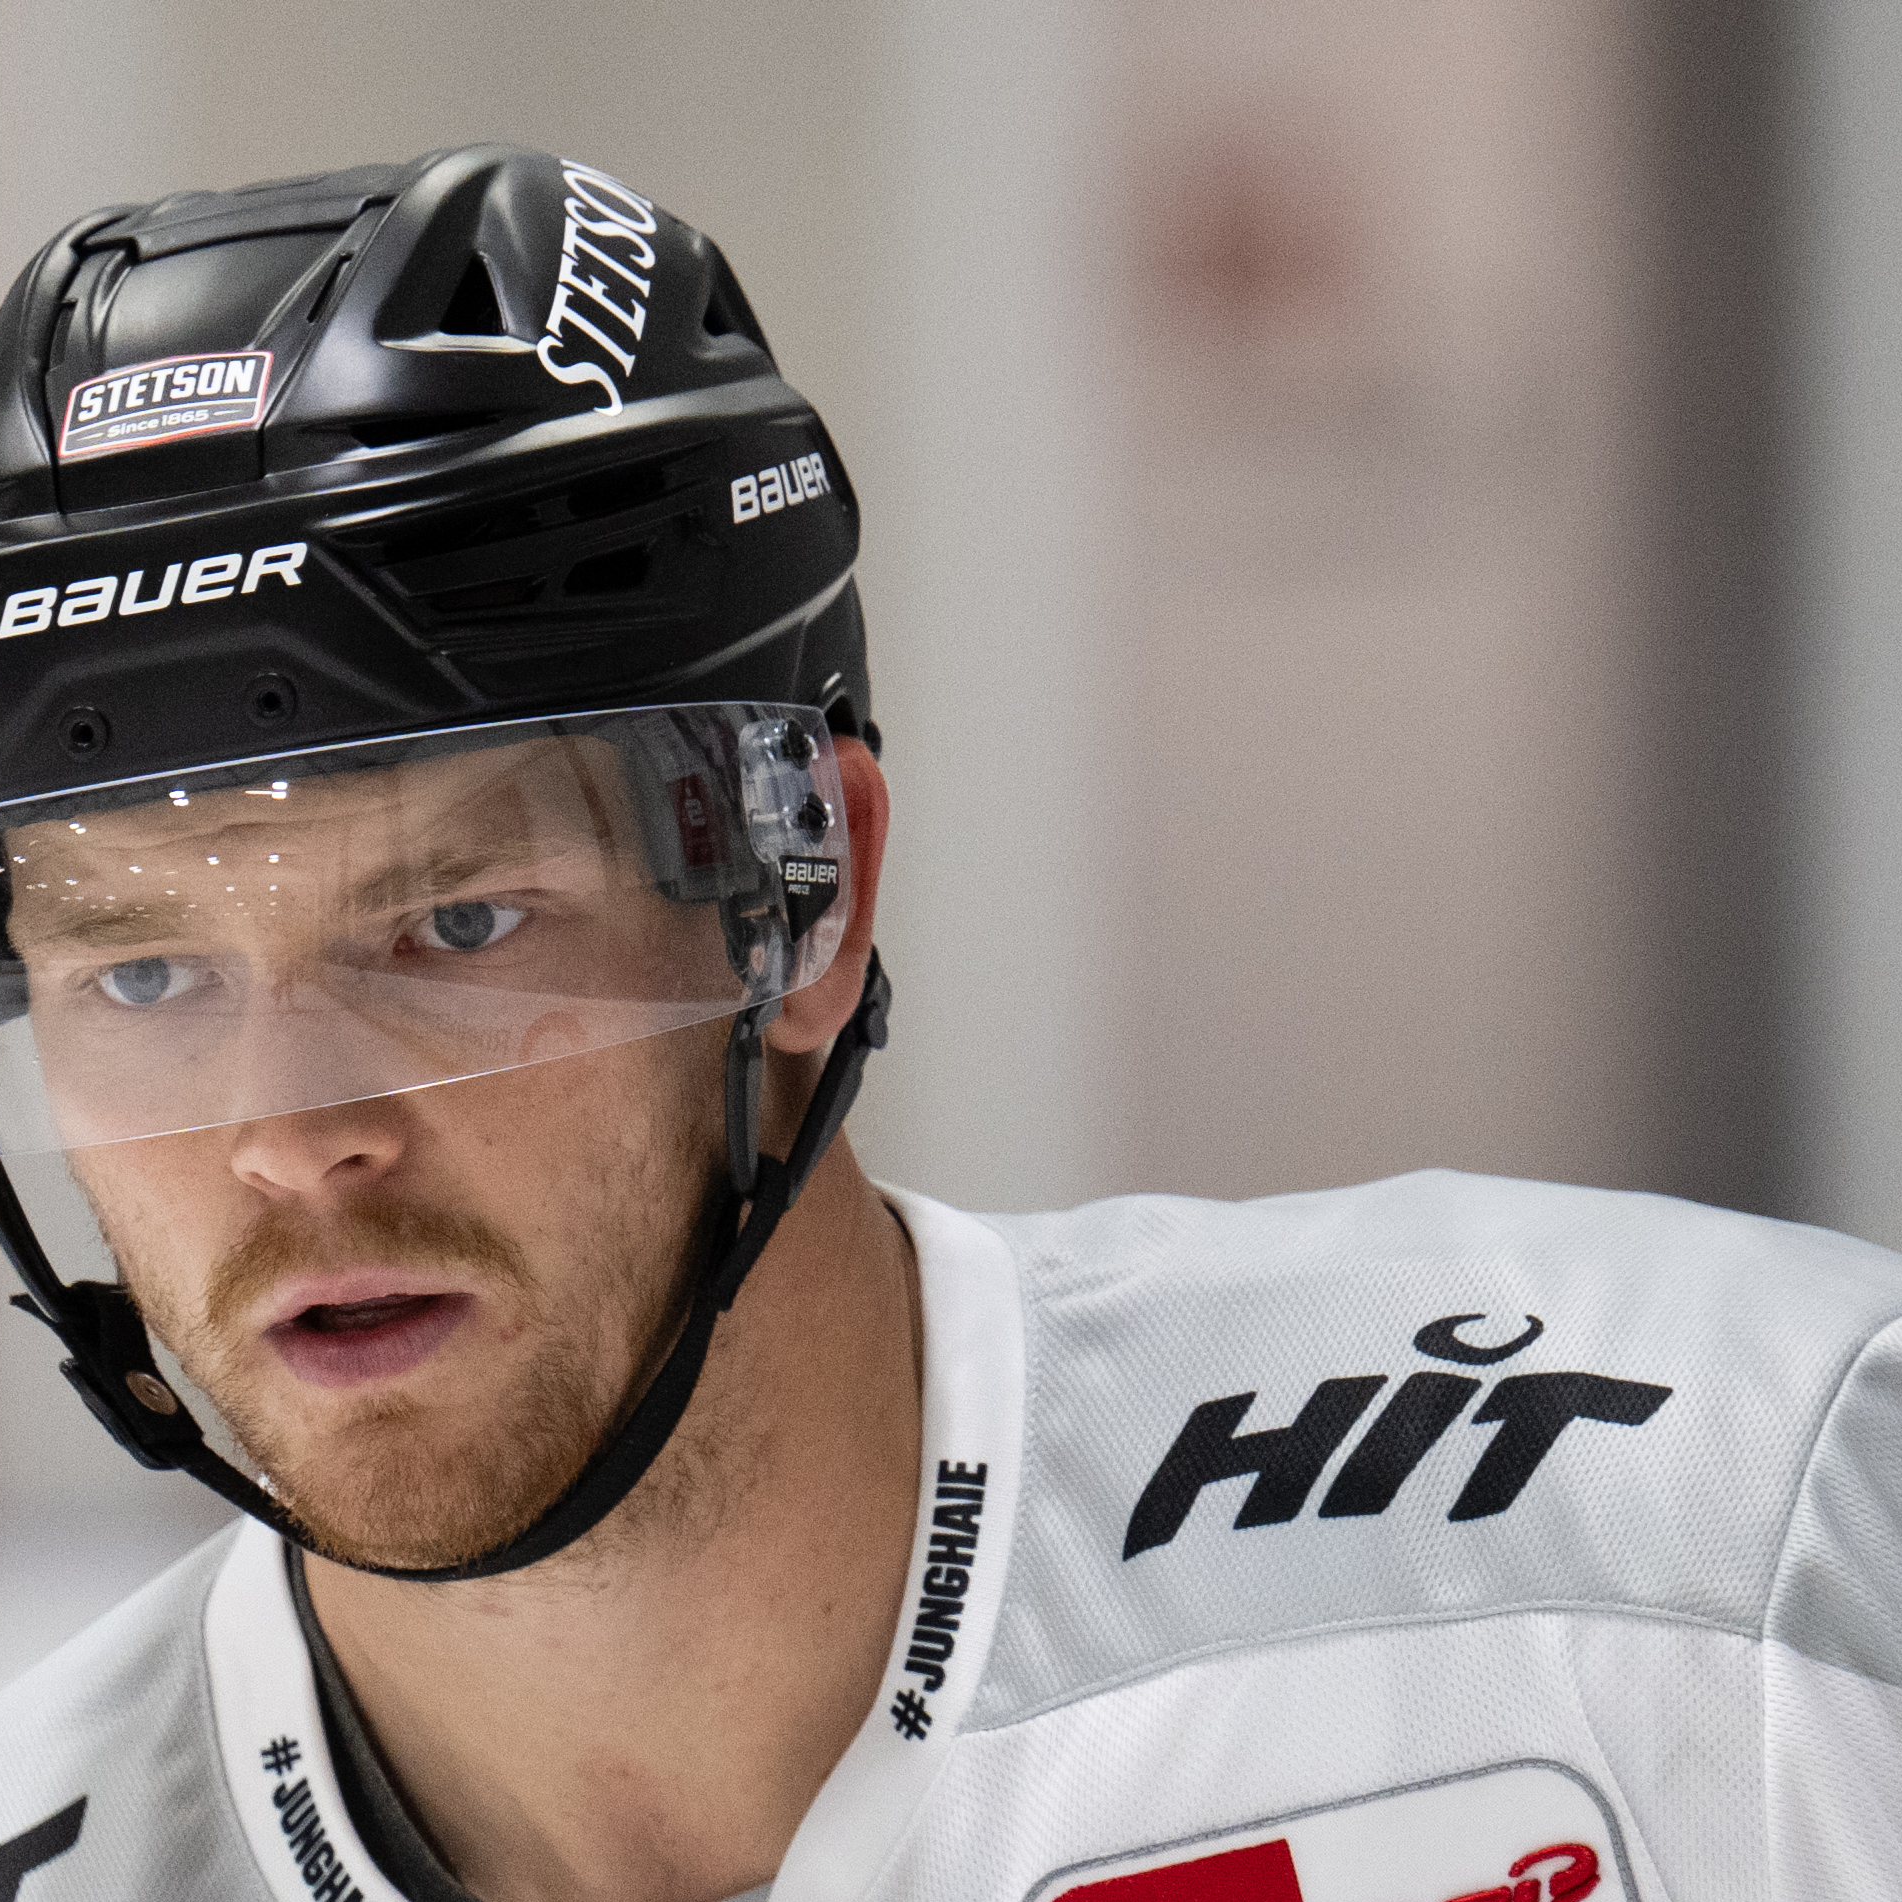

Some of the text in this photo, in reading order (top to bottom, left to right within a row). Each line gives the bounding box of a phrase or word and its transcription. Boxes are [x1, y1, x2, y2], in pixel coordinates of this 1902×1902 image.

[78, 358, 256, 422] STETSON
[107, 409, 209, 439] Since 1865
[1122, 1313, 1674, 1562] HIT
[891, 1460, 988, 1740] #JUNGHAIE
